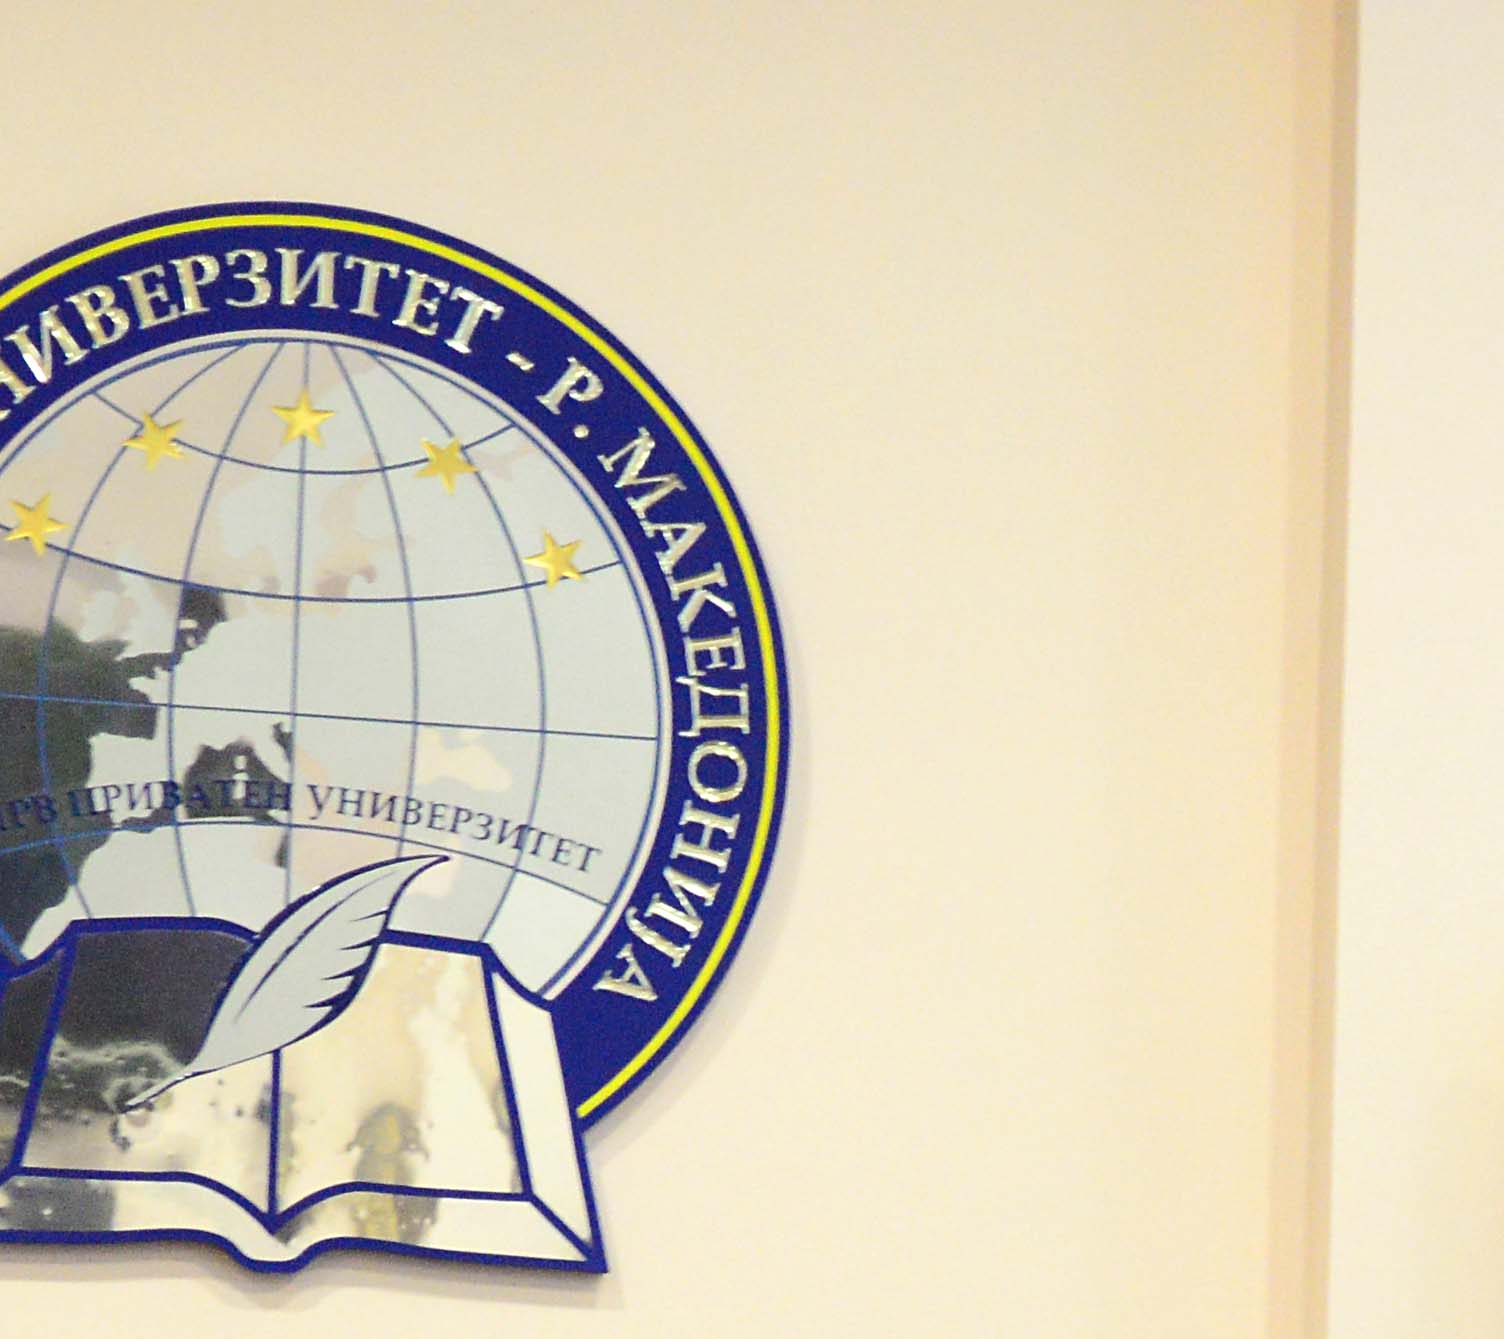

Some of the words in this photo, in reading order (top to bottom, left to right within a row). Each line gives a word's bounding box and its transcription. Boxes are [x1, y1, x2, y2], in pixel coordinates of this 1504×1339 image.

[66, 778, 293, 821] ПРИВАТЕН
[306, 782, 603, 873] УНИВЕРЗИТЕТ
[535, 356, 604, 439] Р.
[592, 426, 751, 1001] МАКЕДОНИЈА
